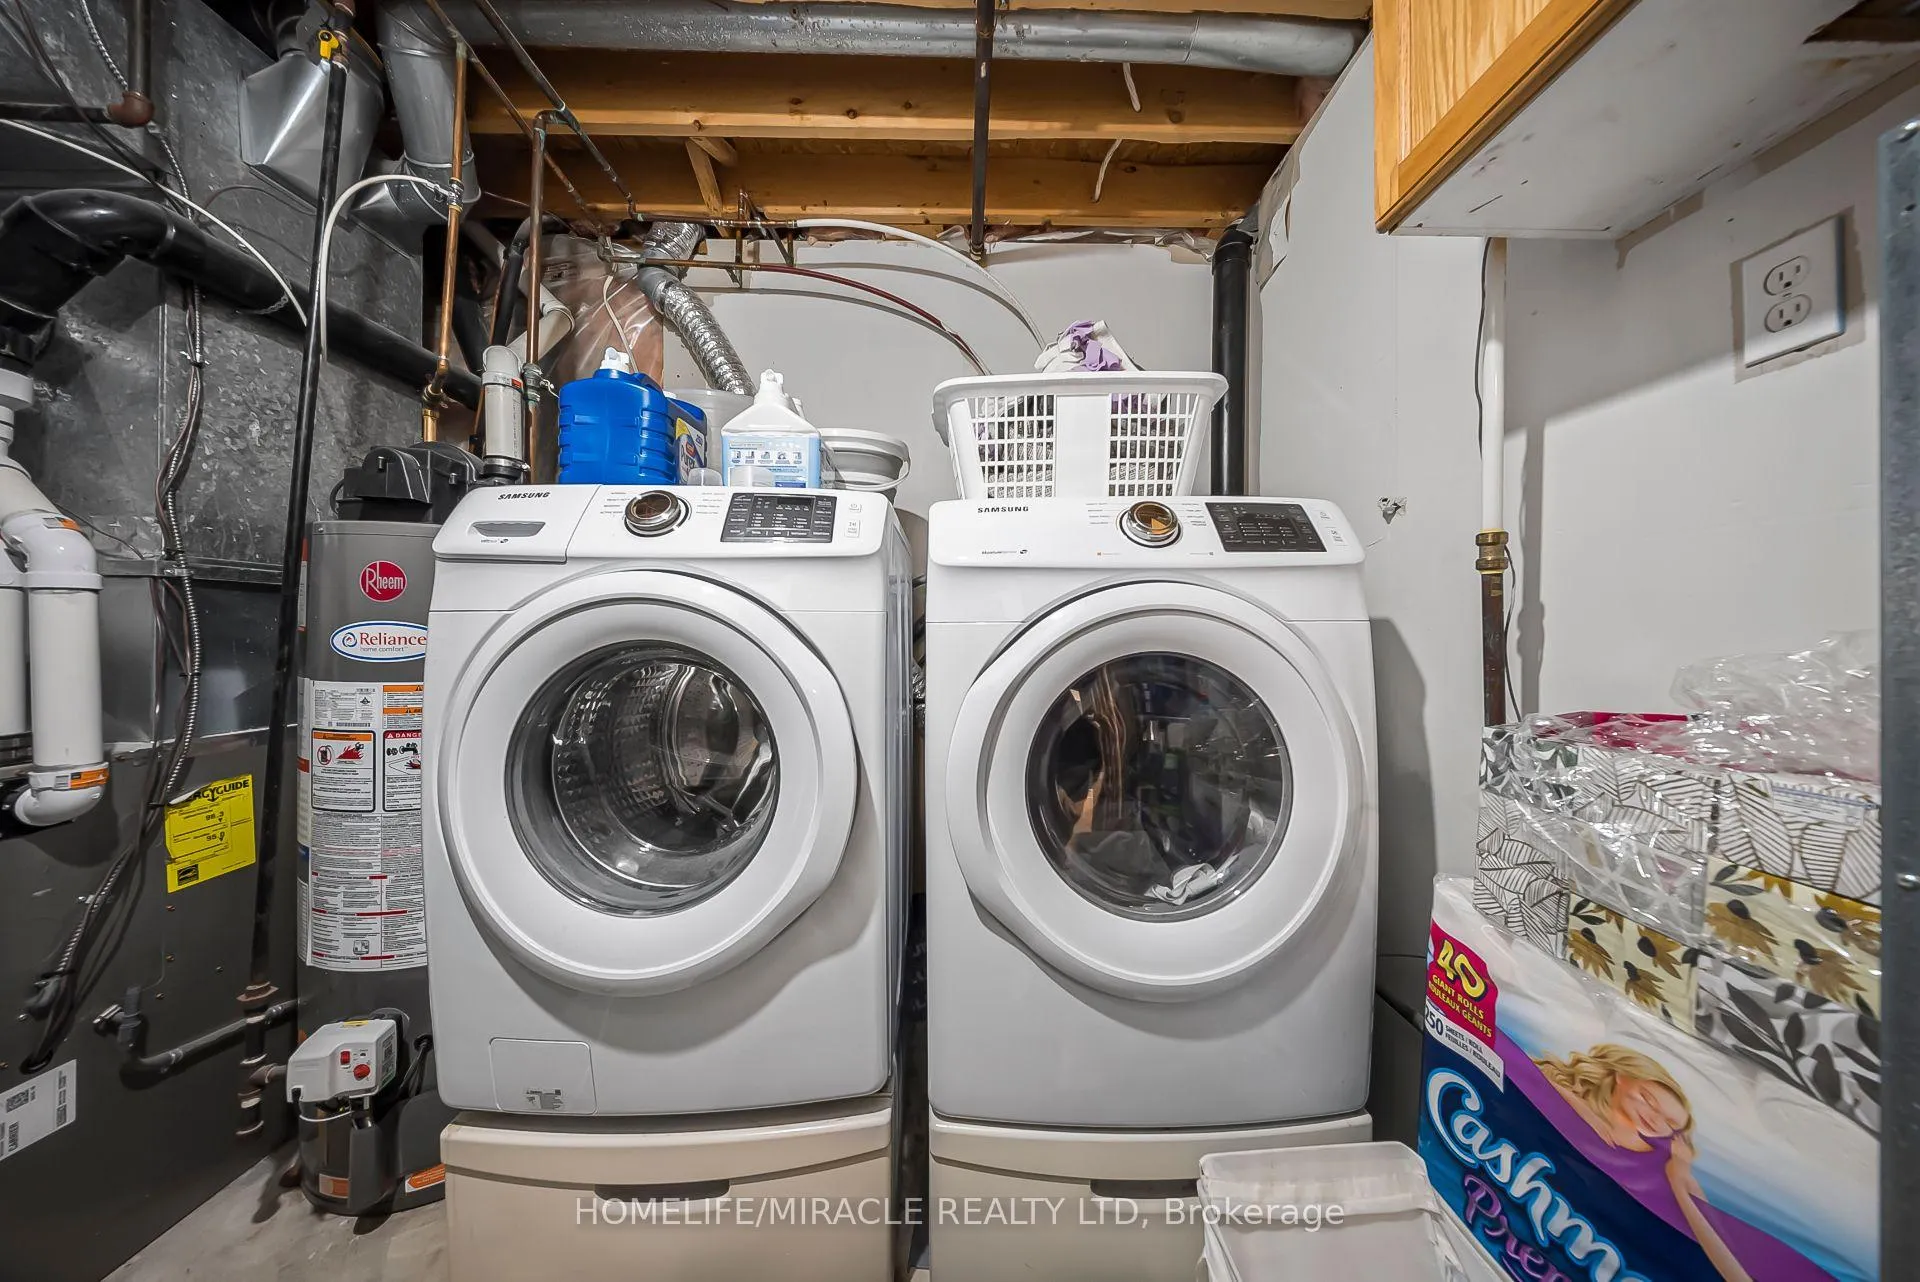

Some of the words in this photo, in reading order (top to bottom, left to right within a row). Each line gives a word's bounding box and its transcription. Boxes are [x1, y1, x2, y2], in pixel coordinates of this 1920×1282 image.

[497, 491, 551, 501] SAMSUNG
[977, 505, 1030, 514] SAMSUNG
[365, 561, 404, 595] Rheem
[360, 632, 427, 646] Reliance
[1436, 939, 1487, 1000] 40
[1428, 980, 1461, 1014] ROULEAUX
[1432, 974, 1456, 997] GIANT
[1457, 993, 1485, 1020] ROLLS
[1445, 1025, 1465, 1042] SHEETS
[1468, 1038, 1484, 1054] ROLL
[1445, 1033, 1469, 1052] FEUILLES
[1472, 1049, 1501, 1078] ROULEAU
[1428, 1070, 1649, 1282] Cashm
